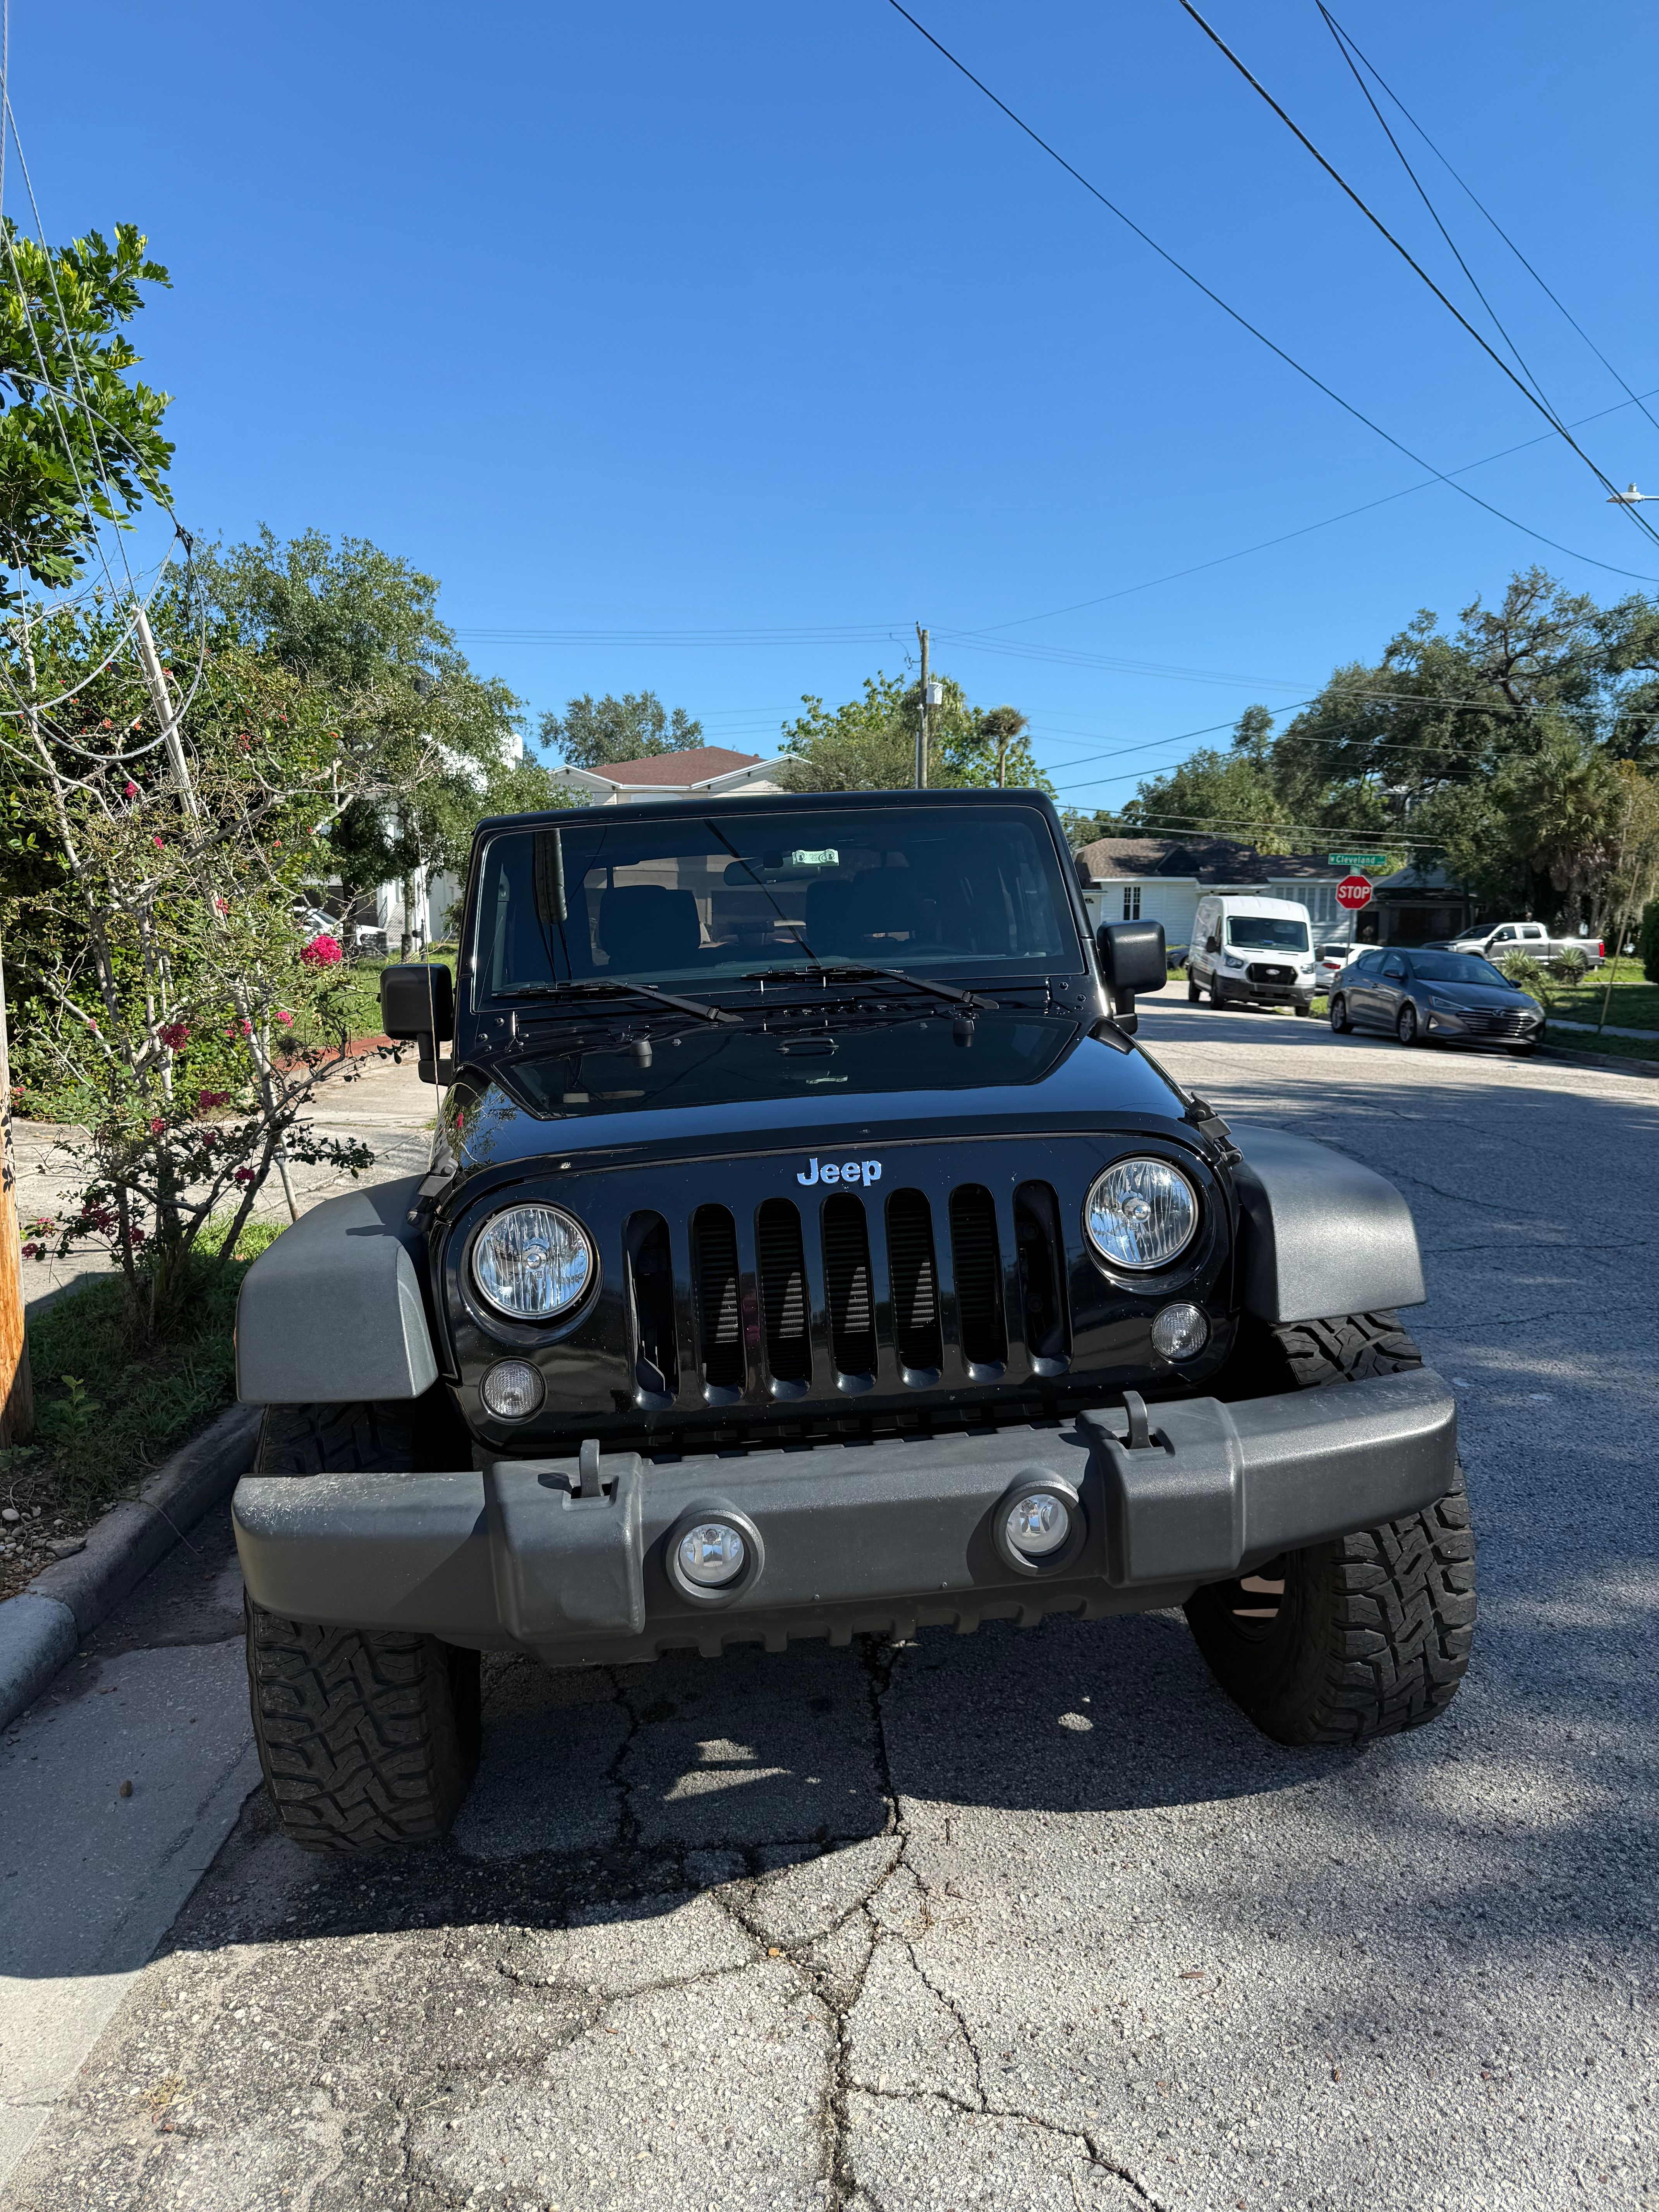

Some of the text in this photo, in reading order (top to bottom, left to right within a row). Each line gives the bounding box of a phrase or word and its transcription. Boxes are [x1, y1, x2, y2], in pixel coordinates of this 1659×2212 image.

[1336, 855, 1375, 864] Cleveland
[1338, 886, 1370, 899] STOP
[797, 1158, 882, 1187] Jeep
